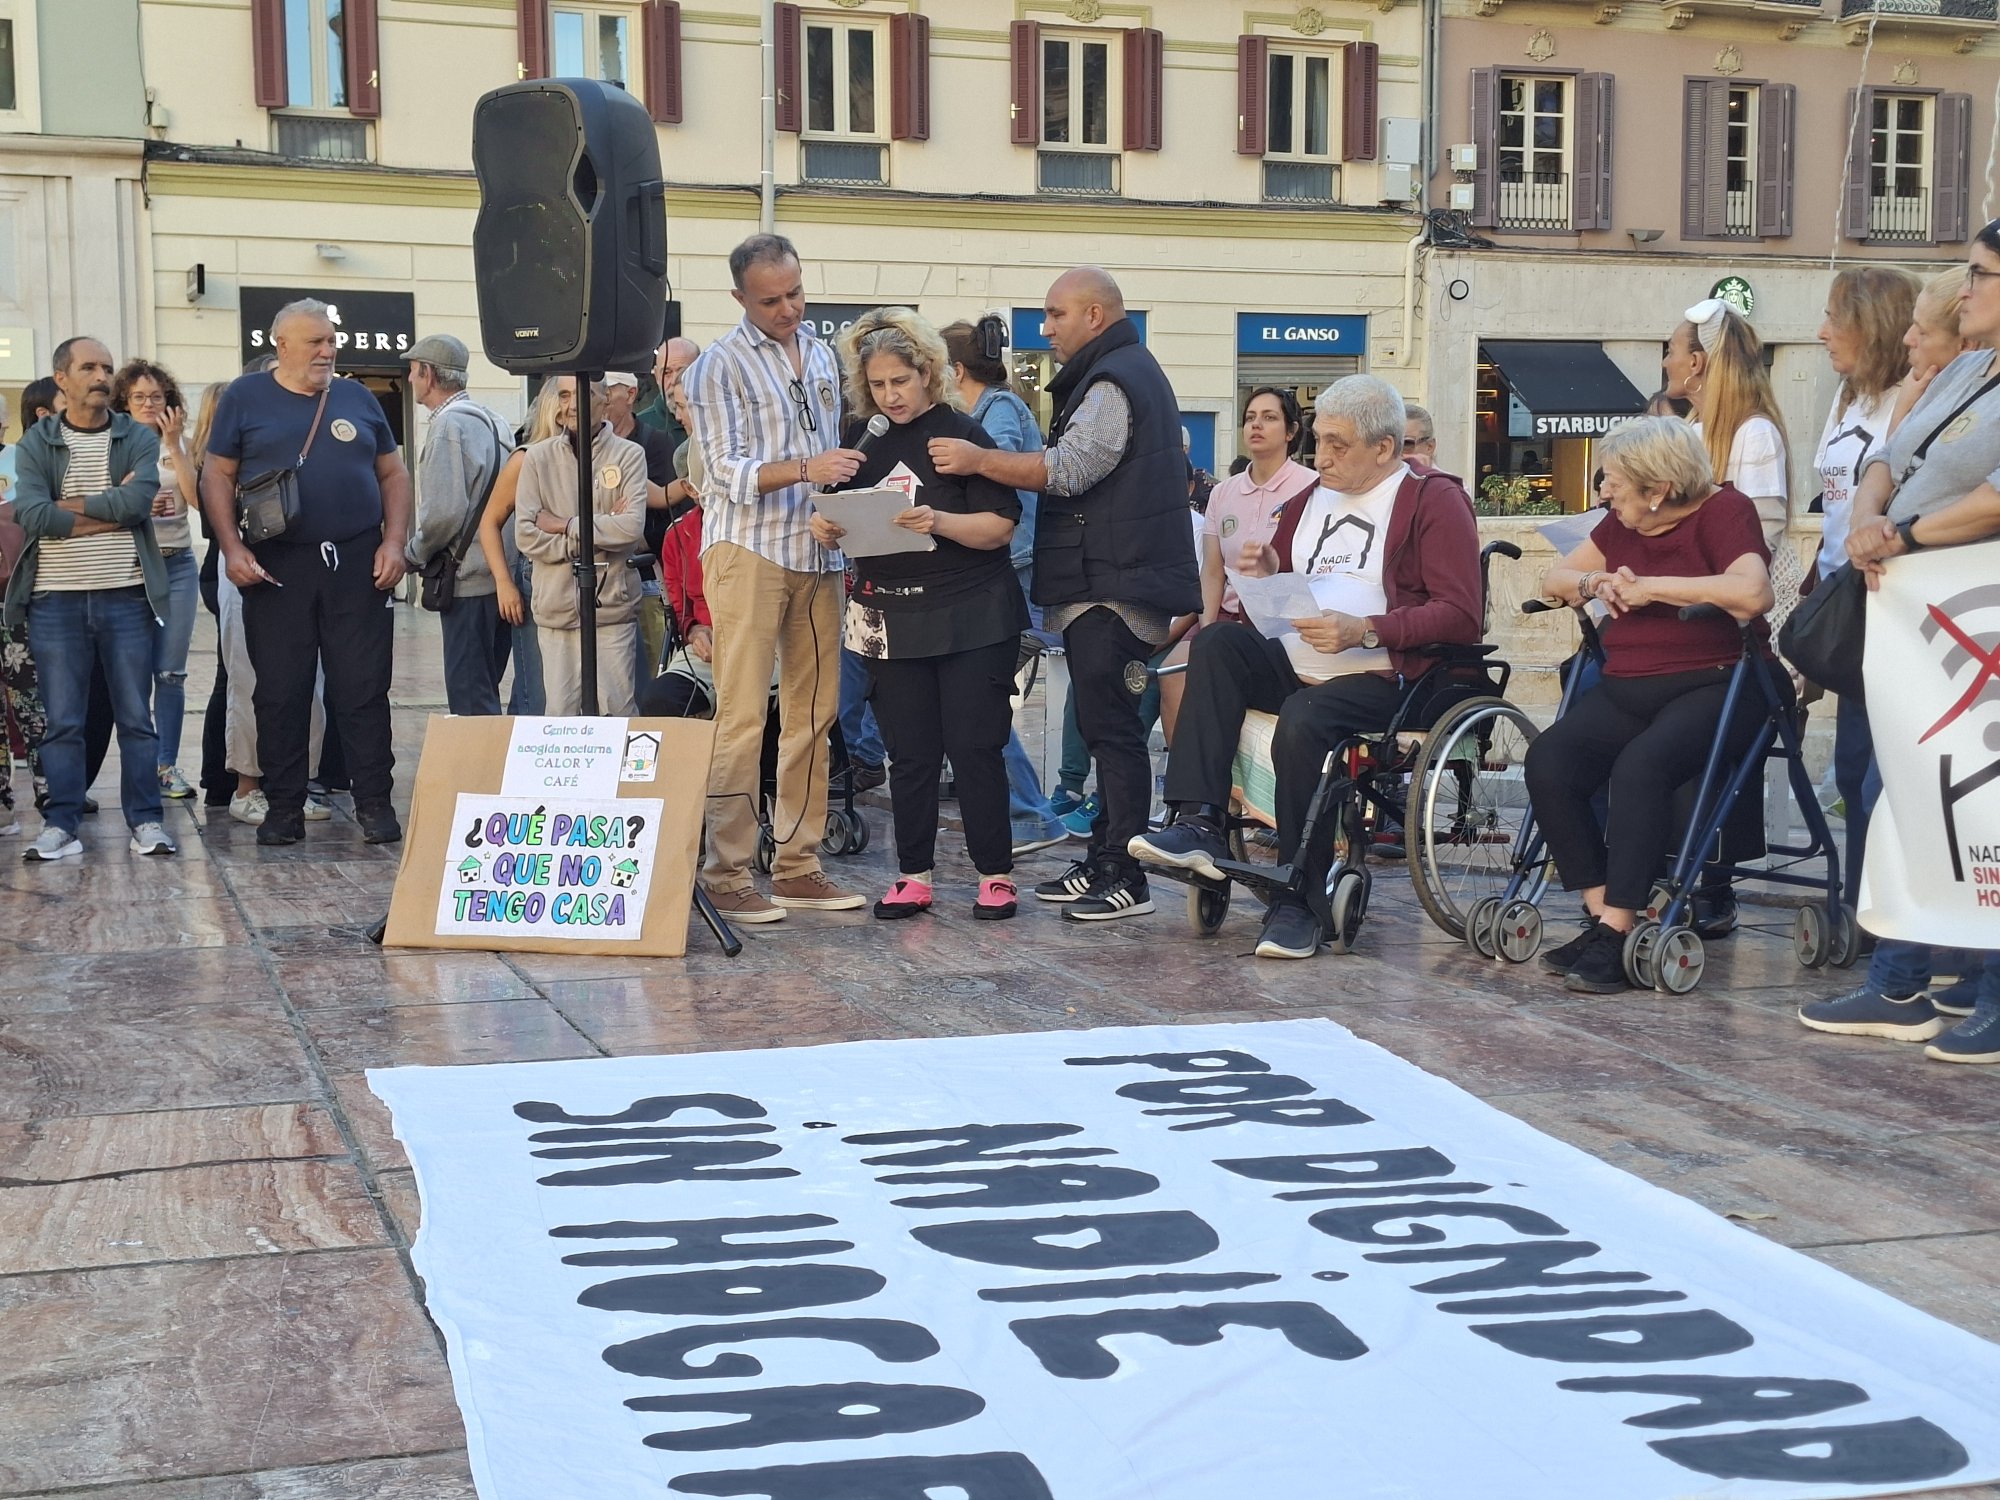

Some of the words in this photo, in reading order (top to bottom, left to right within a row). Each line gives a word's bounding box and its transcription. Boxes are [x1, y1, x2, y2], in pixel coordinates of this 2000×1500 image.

[515, 329, 539, 338] VONYX
[1262, 327, 1281, 340] EL
[1284, 326, 1340, 341] GANSO
[1536, 415, 1644, 434] STARBUC
[1320, 553, 1353, 565] NADIE
[1316, 565, 1335, 574] SIN
[542, 724, 578, 736] Centro
[580, 724, 594, 736] de
[517, 743, 561, 755] acogida
[563, 743, 612, 754] nocturna
[534, 757, 581, 769] CALOR
[585, 757, 595, 769] Y
[543, 773, 579, 787] CAFÉ
[464, 804, 546, 849] ¿QUÉ
[550, 813, 645, 849] PASA?
[492, 851, 553, 888] QUE
[558, 853, 602, 888] NO
[453, 889, 546, 924] TENGO
[551, 892, 626, 926] CASA
[1064, 1049, 1373, 1132] POR
